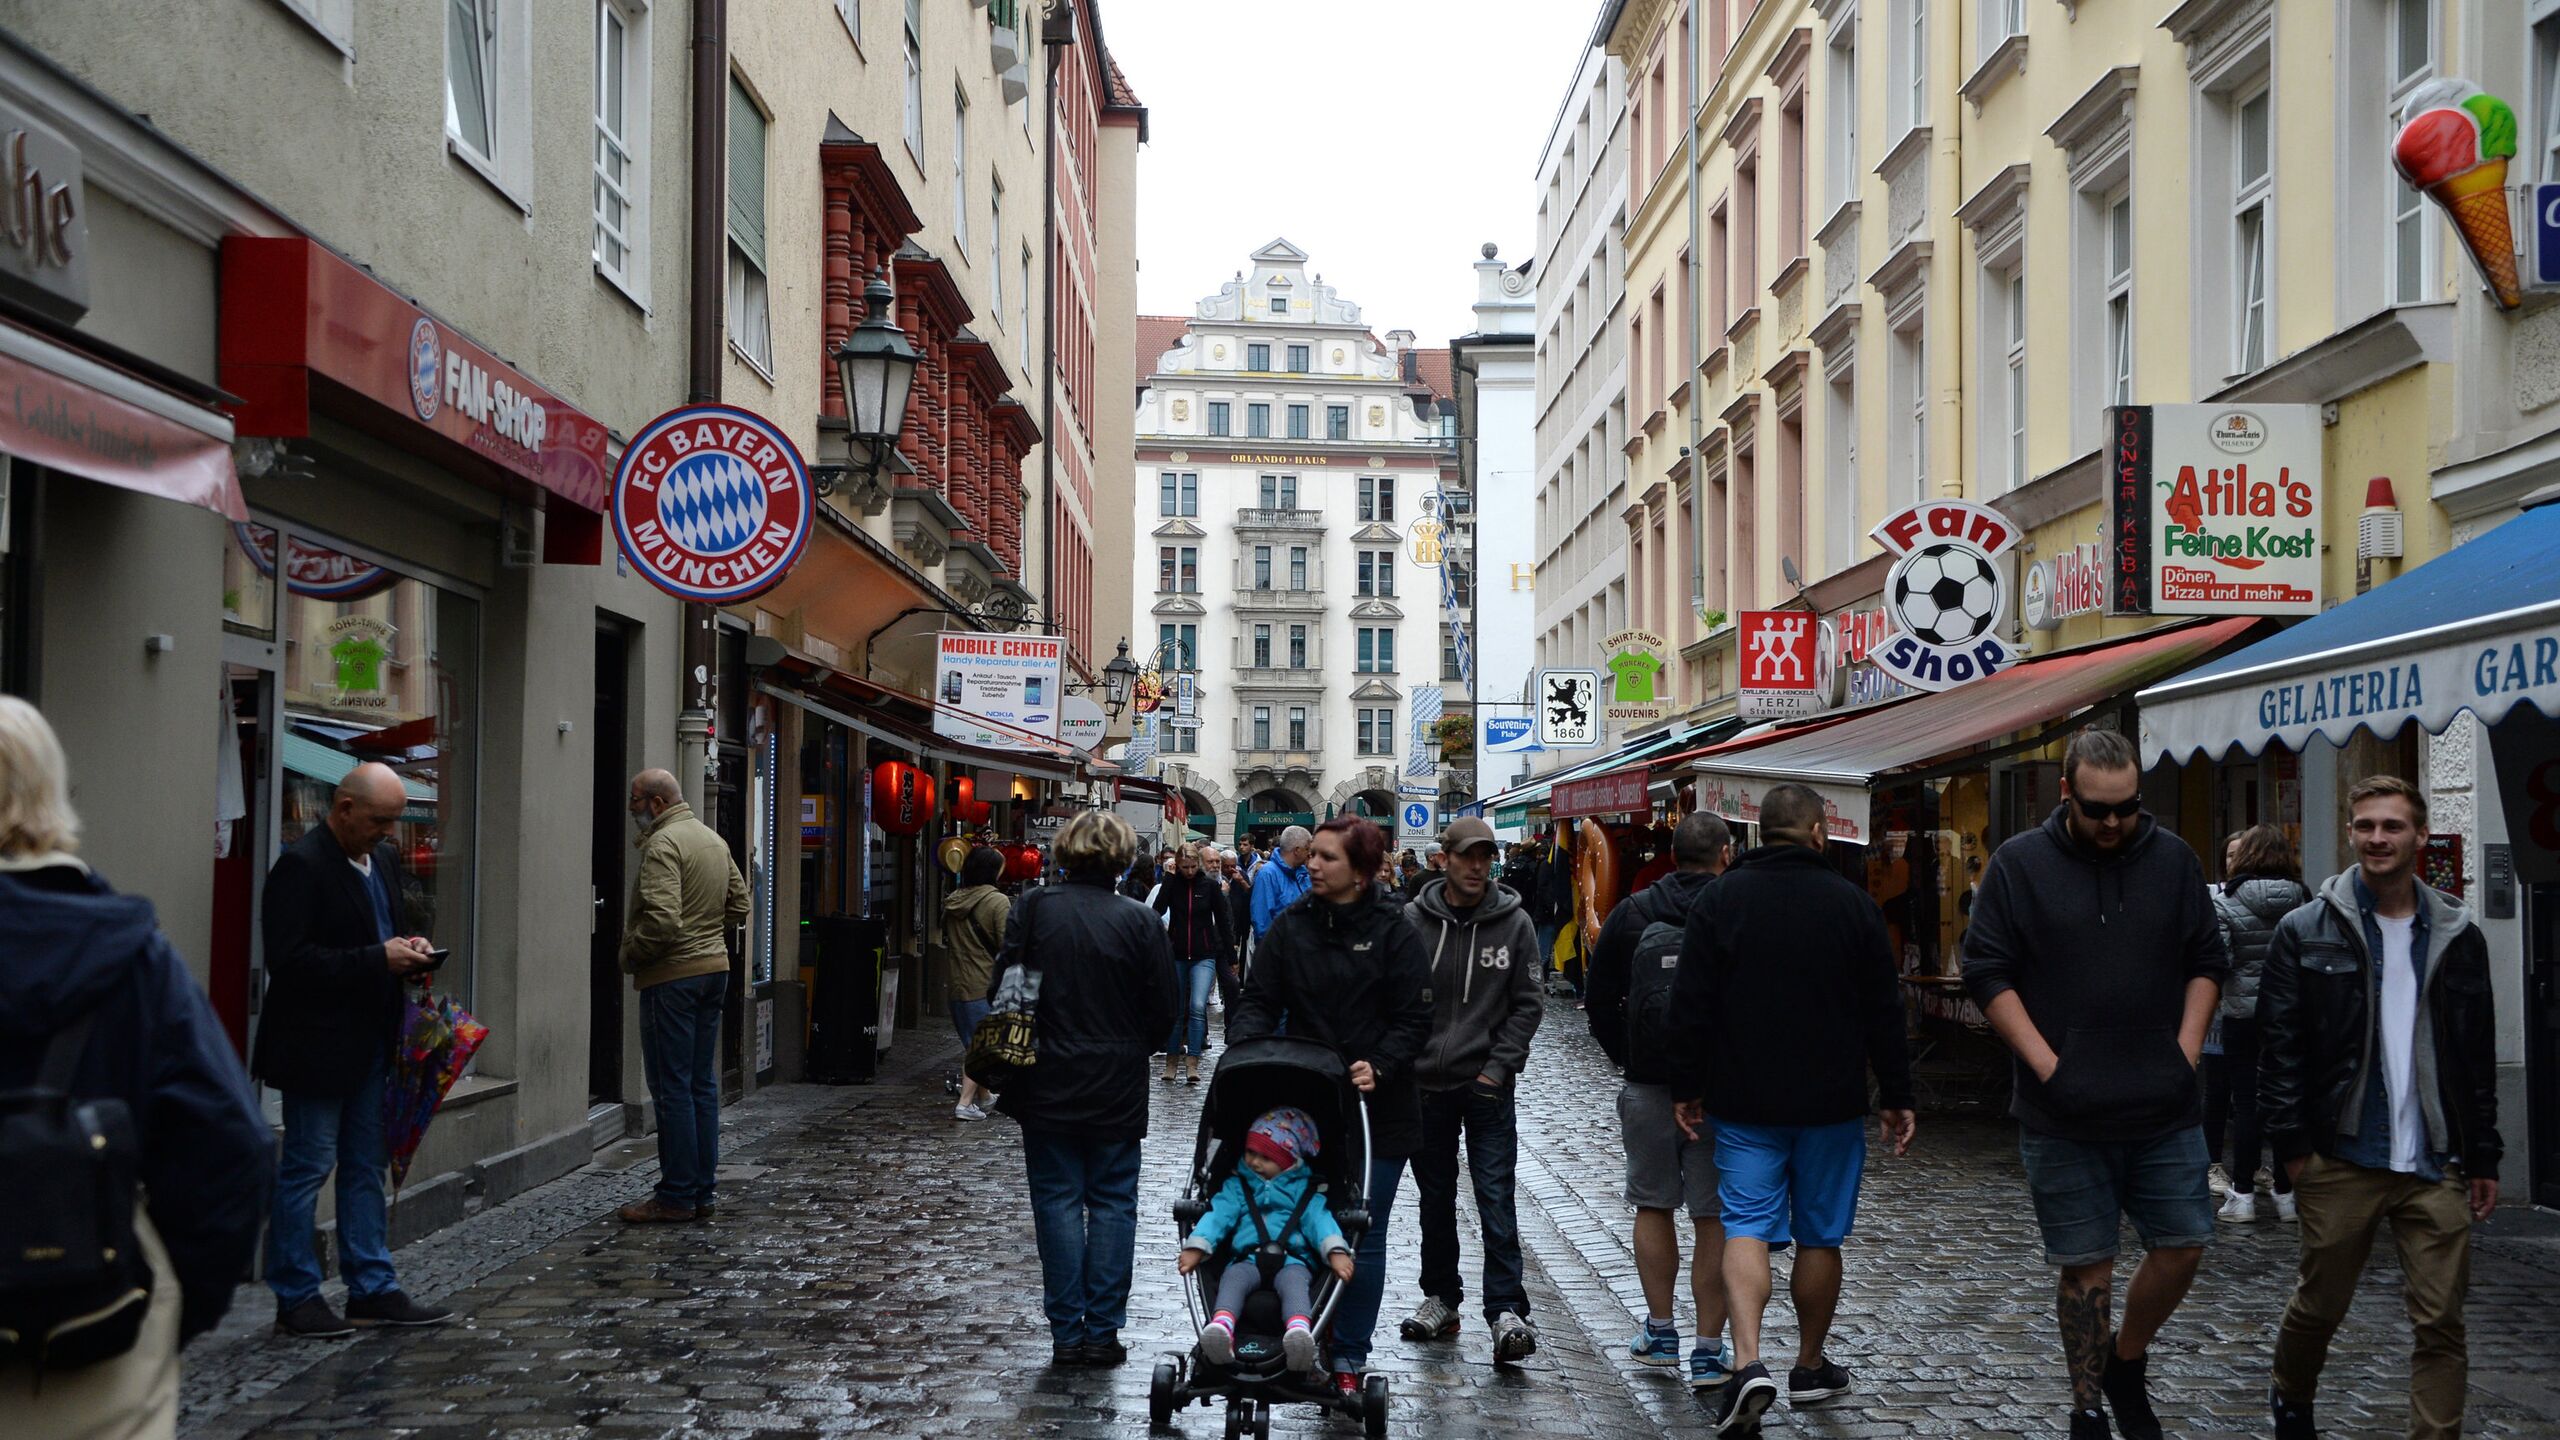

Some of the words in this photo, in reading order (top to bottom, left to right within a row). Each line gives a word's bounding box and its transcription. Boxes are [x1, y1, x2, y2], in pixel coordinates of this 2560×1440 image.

[444, 349, 547, 453] FAN-SHOP
[632, 450, 667, 493] FC
[667, 423, 793, 494] BAYERN
[1230, 454, 1287, 464] ORLANDO
[1295, 456, 1327, 465] HAUS
[2169, 463, 2313, 518] Atila's
[1882, 507, 2007, 554] Fan
[2164, 525, 2242, 558] Feine
[2246, 526, 2315, 559] Kost
[633, 518, 792, 587] MÜNCHEN
[2052, 544, 2104, 619] Atila's
[2165, 568, 2214, 585] Döner,
[2165, 585, 2205, 600] Pizza
[2211, 585, 2239, 600] und
[2244, 586, 2284, 600] mehr
[1607, 632, 1663, 648] SHIRT-SHOP
[942, 638, 998, 656] MOBILE
[1002, 641, 1058, 659] CENTER
[943, 655, 973, 666] Handy
[975, 656, 1021, 668] Reparatur
[1021, 658, 1042, 668] aller
[1043, 659, 1057, 669] Art
[966, 678, 1022, 687] Reparaturannahme
[997, 673, 1017, 681] Tausch
[2258, 662, 2424, 730] GELATERIA
[2474, 636, 2560, 697] GAR
[979, 685, 1008, 693] Ersatzteile
[1756, 697, 1801, 708] TERZI
[985, 711, 1015, 719] NOKIA
[1608, 708, 1660, 719] SOUVENIRS
[1749, 707, 1808, 716] Stahlwaren
[1062, 719, 1102, 727] nzmurr
[1488, 719, 1530, 730] Souvenirs
[976, 731, 992, 740] Lyca
[1553, 728, 1585, 739] 1860
[1258, 816, 1294, 824] ORLANDO
[1407, 828, 1427, 836] ZONE
[1479, 945, 1511, 970] 58
